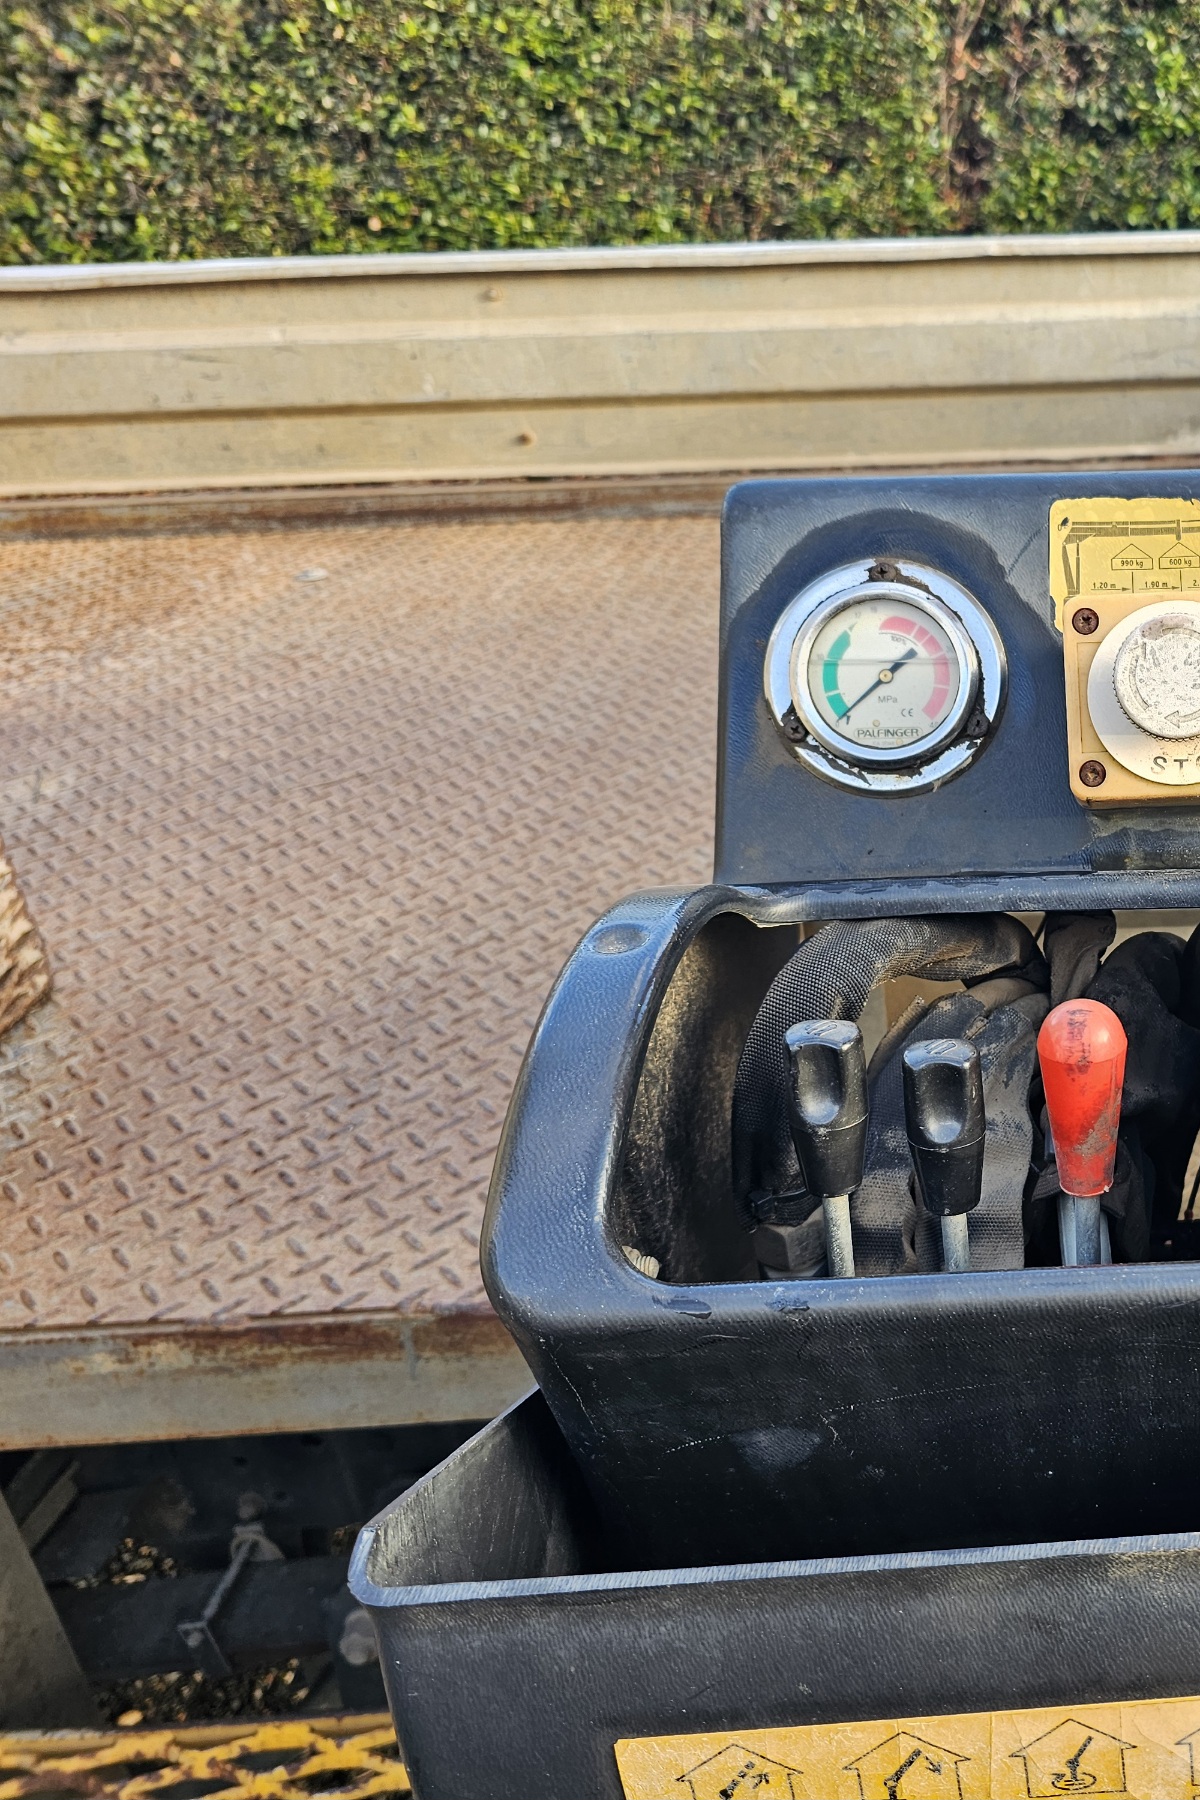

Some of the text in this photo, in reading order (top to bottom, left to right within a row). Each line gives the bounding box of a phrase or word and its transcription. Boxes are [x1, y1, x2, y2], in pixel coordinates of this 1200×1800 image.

[1120, 559, 1144, 568] 990 kg
[1169, 558, 1192, 567] 600 kg
[1092, 581, 1108, 589] 1.20
[877, 695, 898, 704] MPa
[857, 728, 920, 738] PALFINGER
